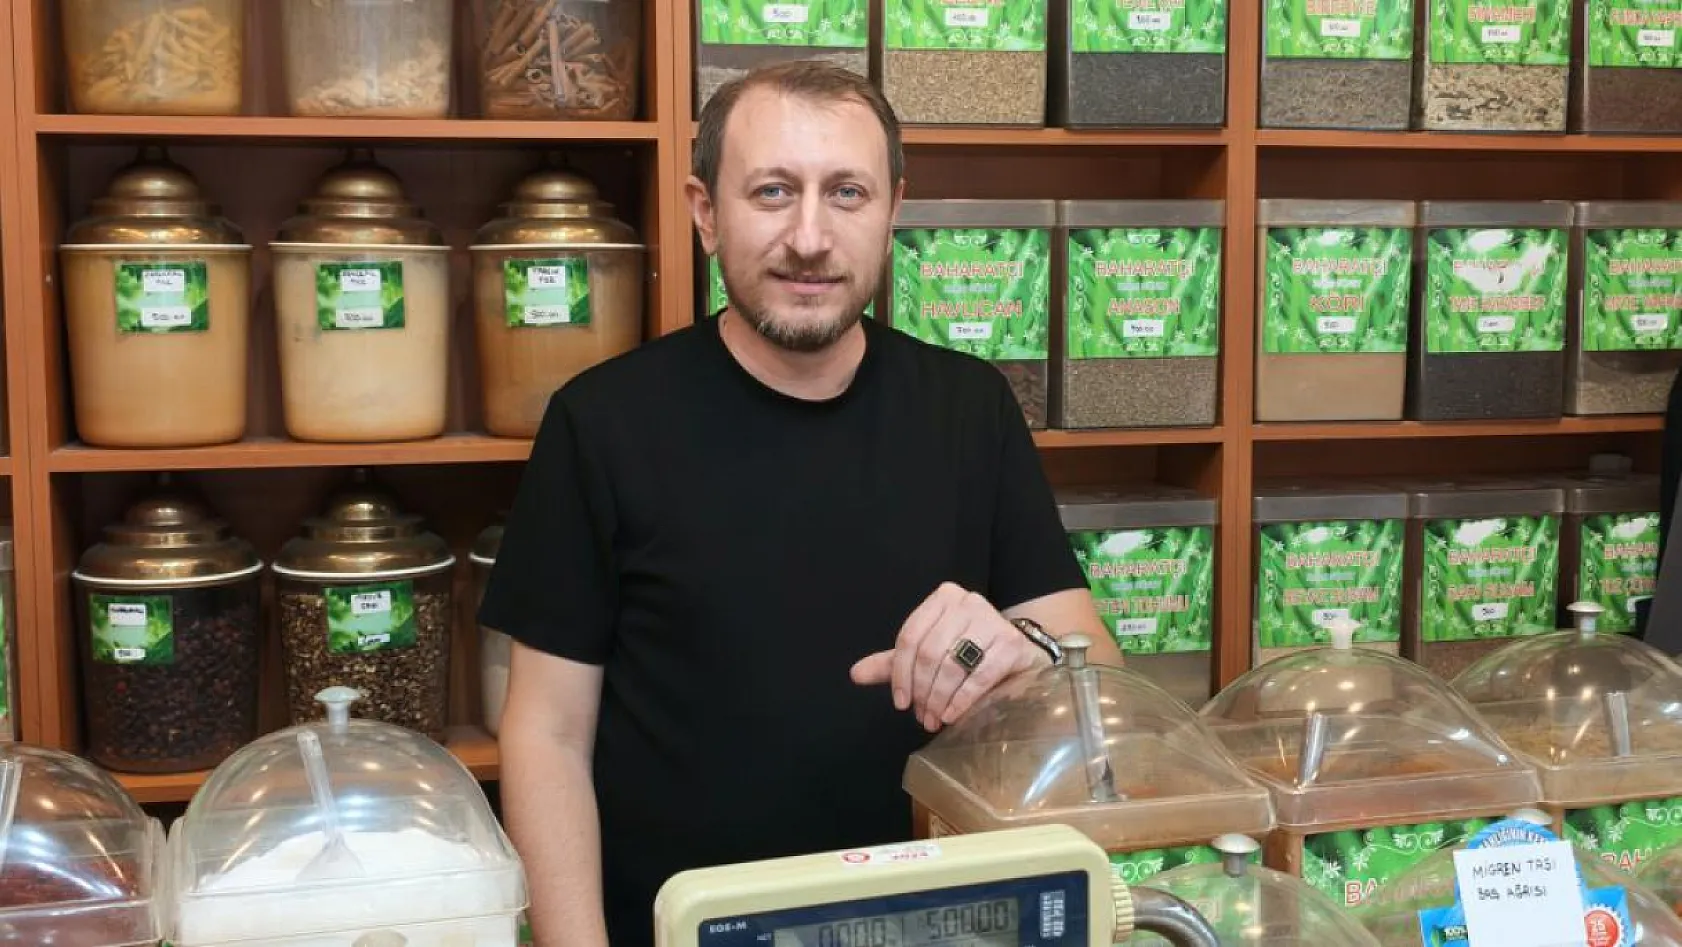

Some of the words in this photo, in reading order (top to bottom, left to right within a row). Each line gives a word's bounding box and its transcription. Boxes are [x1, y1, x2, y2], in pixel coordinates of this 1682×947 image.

[921, 260, 1023, 279] BAHARATÇI
[1096, 259, 1194, 279] BAHARATÇI
[1292, 258, 1388, 279] BAHARATÇI
[1108, 298, 1181, 315] ANASON
[1286, 550, 1381, 569] BAHARATÇI
[1447, 547, 1537, 566] BAHARATÇI
[1089, 559, 1187, 579] BAHARATÇI
